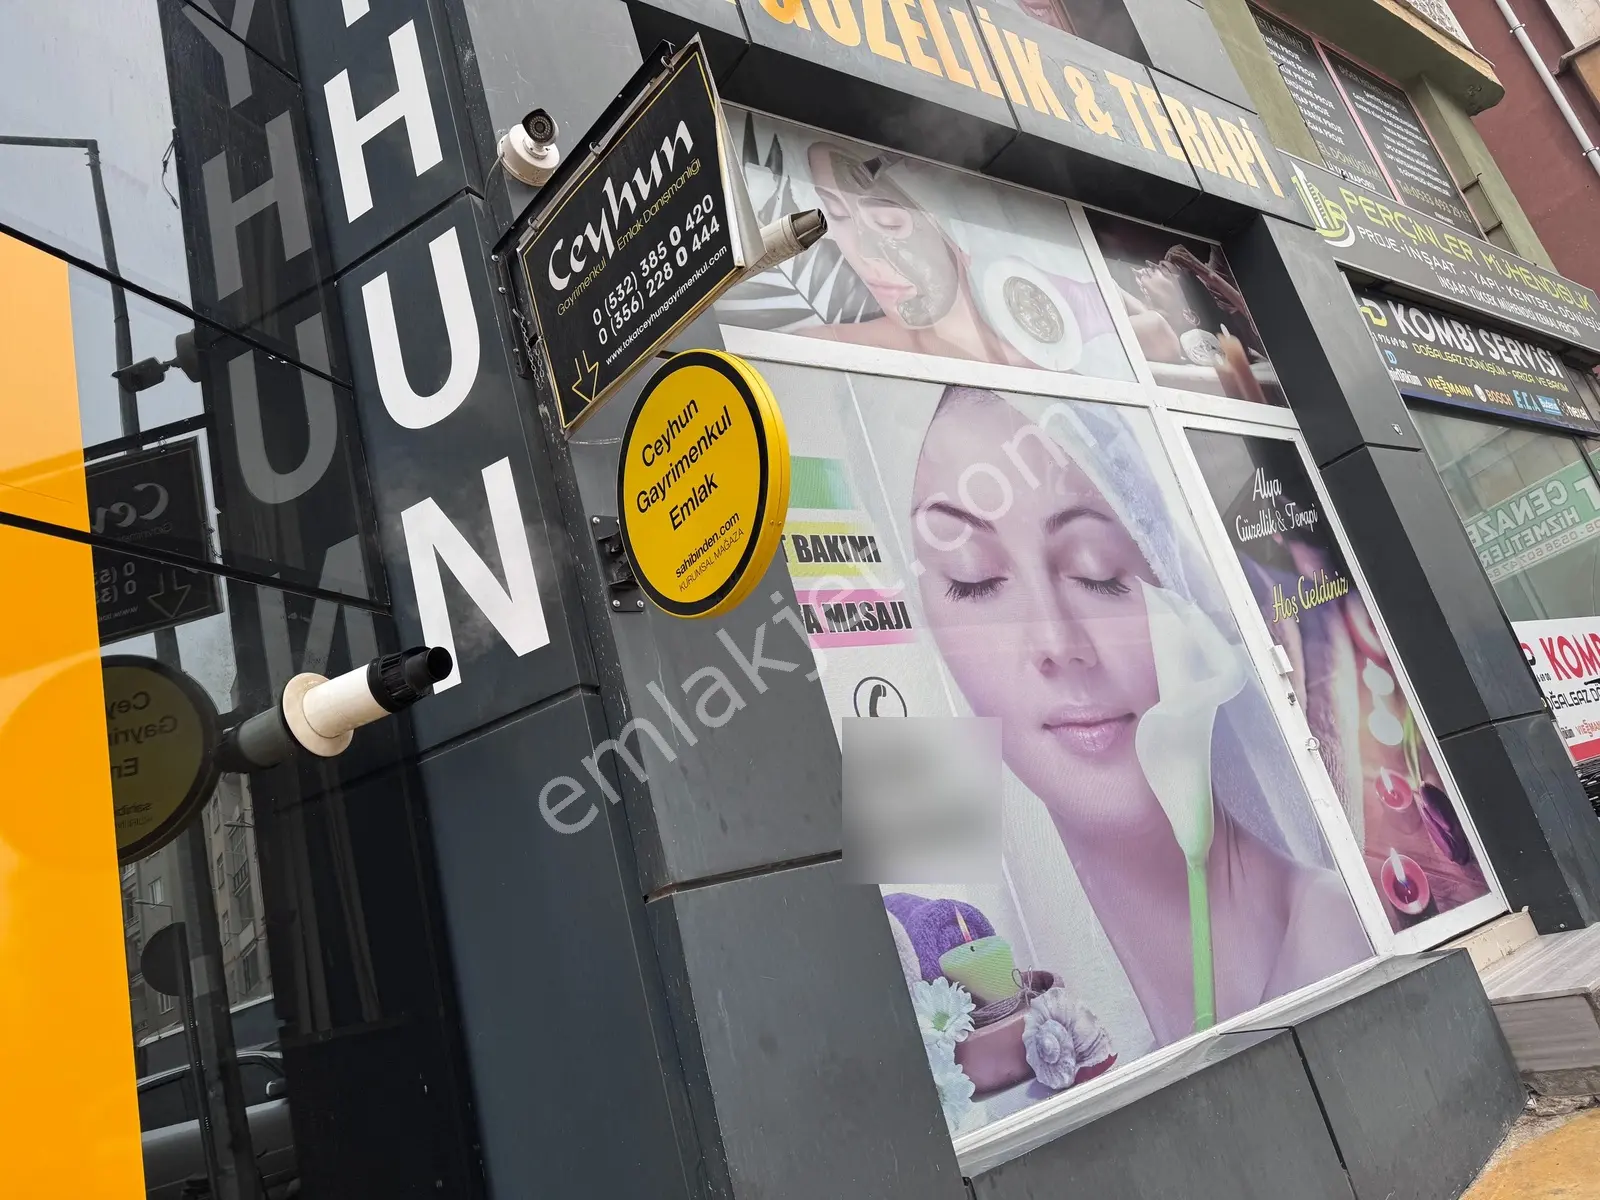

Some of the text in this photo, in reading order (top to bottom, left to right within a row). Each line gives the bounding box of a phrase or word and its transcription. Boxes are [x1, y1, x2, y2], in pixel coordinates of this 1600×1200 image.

[1279, 44, 1301, 62] PROJE
[1292, 71, 1315, 89] PROJE
[1296, 63, 1317, 80] PROJE
[1308, 101, 1331, 117] PROJE
[1313, 93, 1335, 110] PROJE
[1322, 118, 1344, 135] PROJE
[1063, 65, 1123, 140] &
[1103, 69, 1285, 197] TERAPİ
[1322, 128, 1345, 146] PROJE
[548, 120, 694, 291] Ceyhun
[557, 158, 701, 316] Gayrimenkul Emlak Danışmanlığı
[592, 194, 714, 326] 0 (532) 385 0 420
[1339, 187, 1597, 315] PERÇİNLER MÜHENDİSLİK
[598, 215, 720, 345] 0 (356) 228 0 444
[1357, 225, 1401, 253] PROJE
[1469, 270, 1501, 293] YAPI
[1505, 284, 1559, 315] KENTSEL
[1435, 272, 1470, 296] İNŞAAT
[605, 245, 728, 365] www.tokatceyhungayrimenkul.com
[324, 0, 550, 694] HUN
[1387, 300, 1564, 378] KOMBİ SERVİSİ
[1412, 343, 1465, 366] DOĞALGAZ
[1464, 356, 1508, 376] DÖNÜŞÜM
[1484, 389, 1514, 407] BOSCH
[636, 405, 733, 513] Gayrimenkul
[641, 399, 699, 467] Ceyhun
[669, 473, 719, 531] Emlak
[1252, 467, 1282, 507] Alya
[675, 512, 740, 578] sahibinden.com
[791, 534, 882, 563] BAKIMI
[1235, 502, 1319, 542] Güzellik & Terapi
[679, 528, 744, 592] KURUMSAL MAĞAZA
[822, 601, 913, 633] MASAJI
[1273, 569, 1349, 623] Hoş Geldiniz
